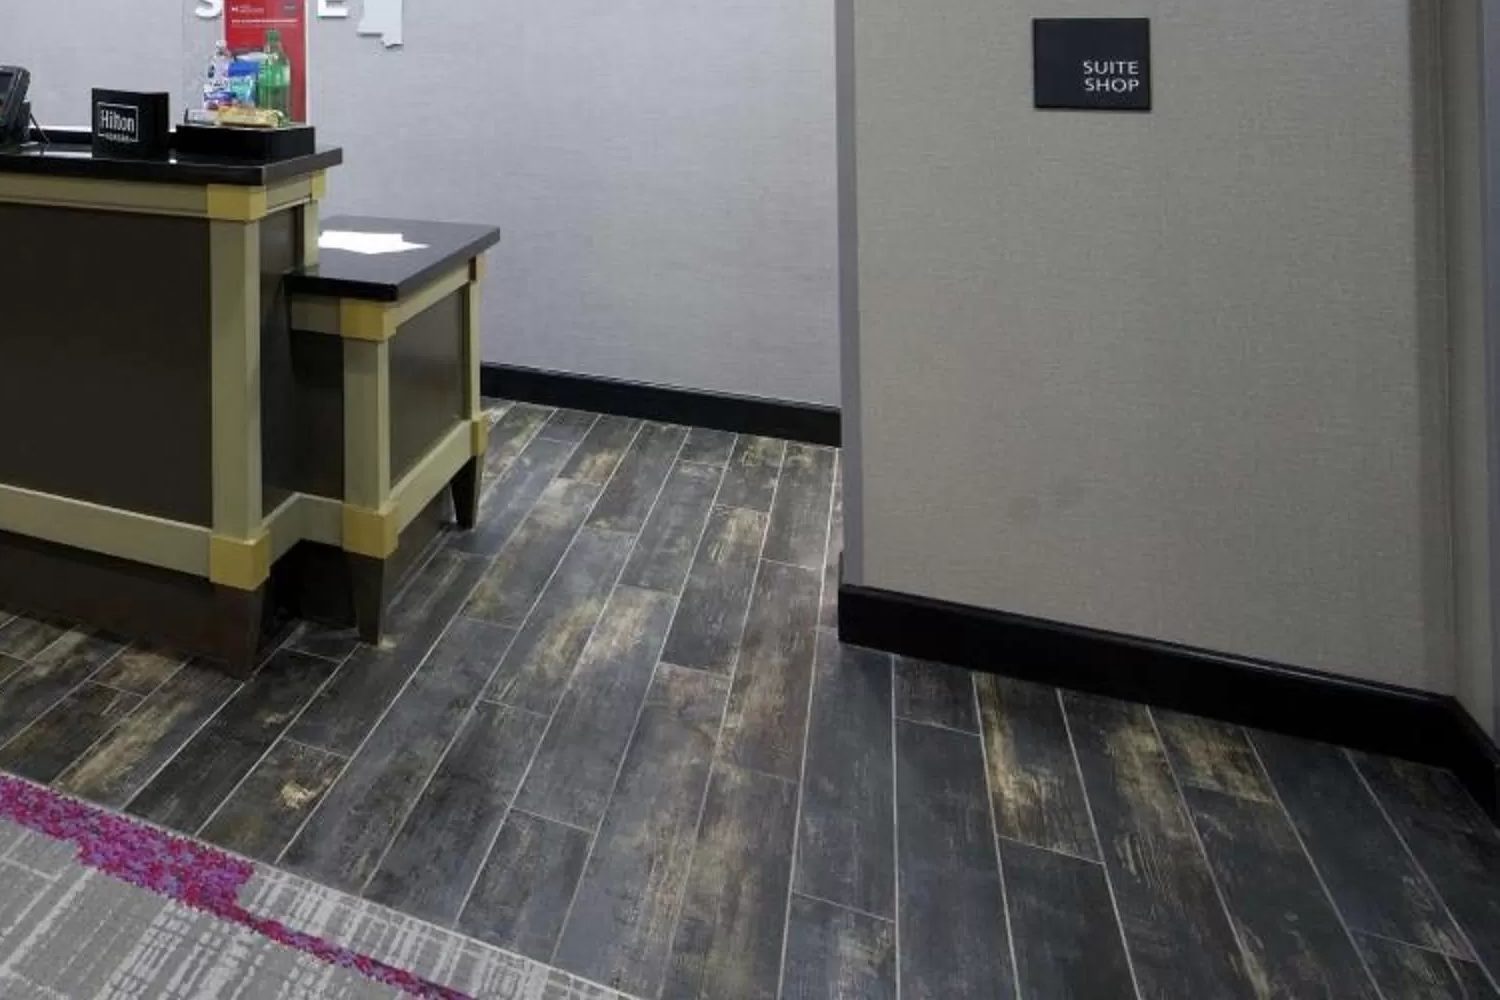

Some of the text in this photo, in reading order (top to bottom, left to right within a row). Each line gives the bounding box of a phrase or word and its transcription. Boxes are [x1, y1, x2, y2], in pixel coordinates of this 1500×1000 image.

[1083, 61, 1139, 75] SUITE
[1084, 78, 1140, 92] SHOP
[101, 110, 135, 132] Hilton
